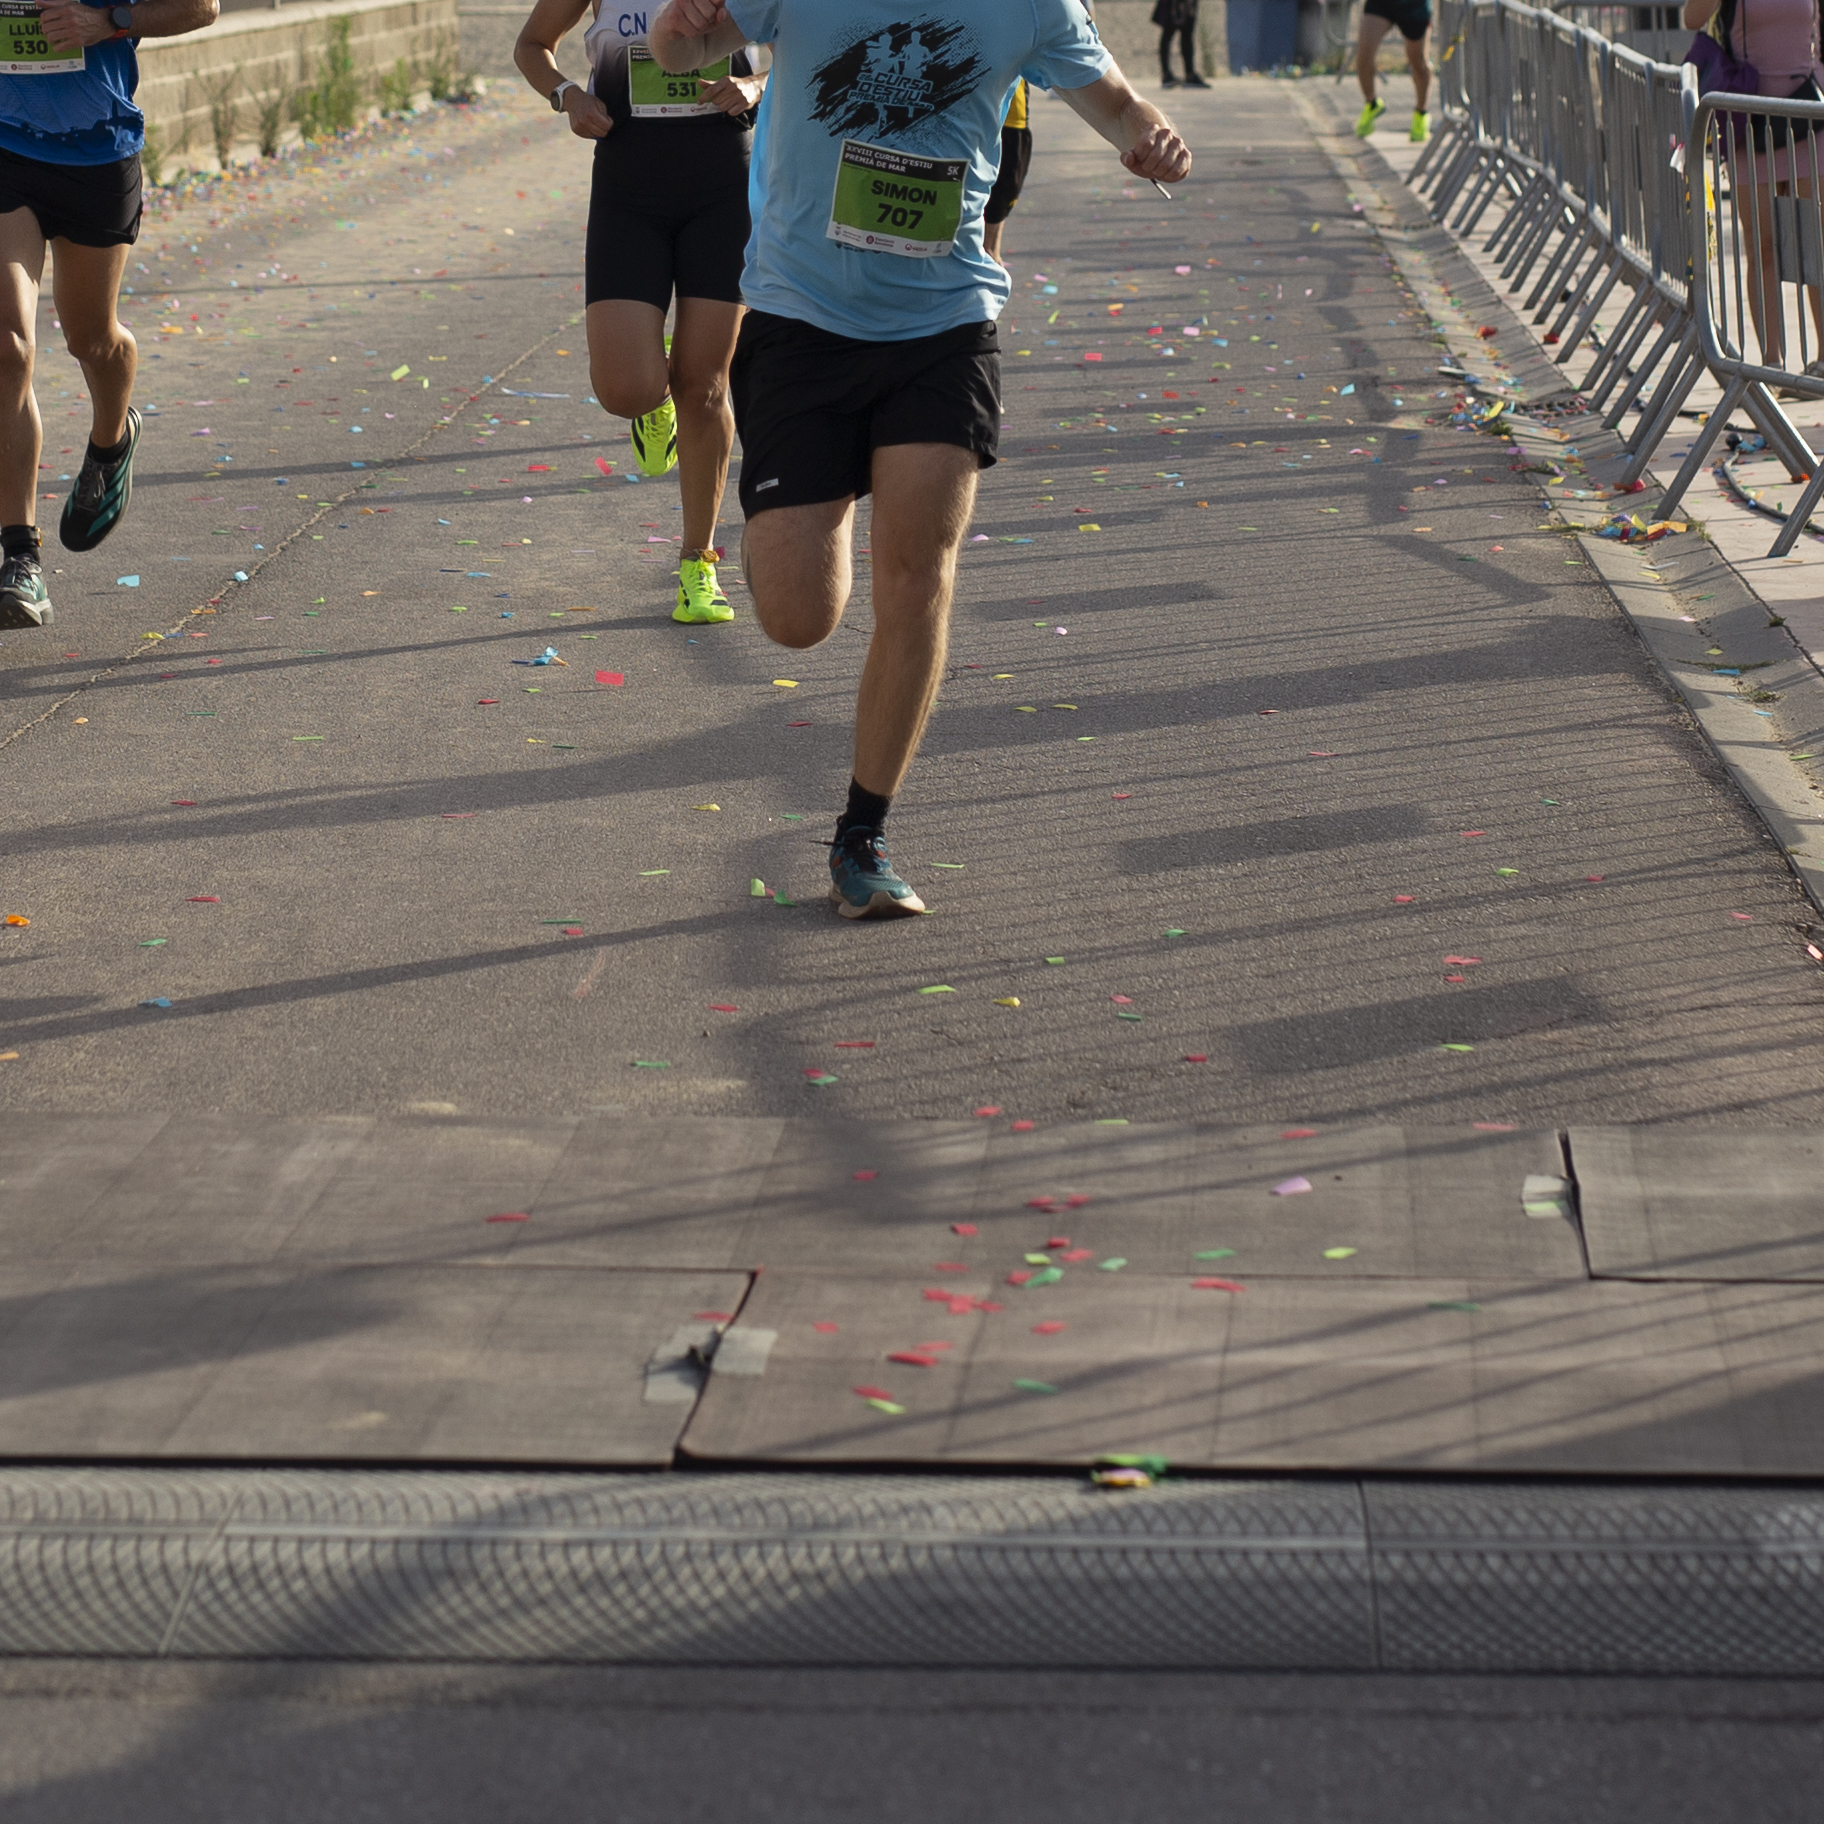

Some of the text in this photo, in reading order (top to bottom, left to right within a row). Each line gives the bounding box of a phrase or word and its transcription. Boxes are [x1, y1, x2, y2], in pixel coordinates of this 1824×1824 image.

[13, 40, 48, 54] 530
[667, 82, 697, 97] 531
[874, 72, 932, 93] CURSA
[845, 144, 873, 157] XXVIII
[874, 151, 900, 163] CURSA
[876, 160, 886, 169] DE
[888, 163, 906, 173] MAR
[946, 165, 960, 176] 5K
[871, 179, 938, 206] SIMON
[876, 202, 924, 230] 707
